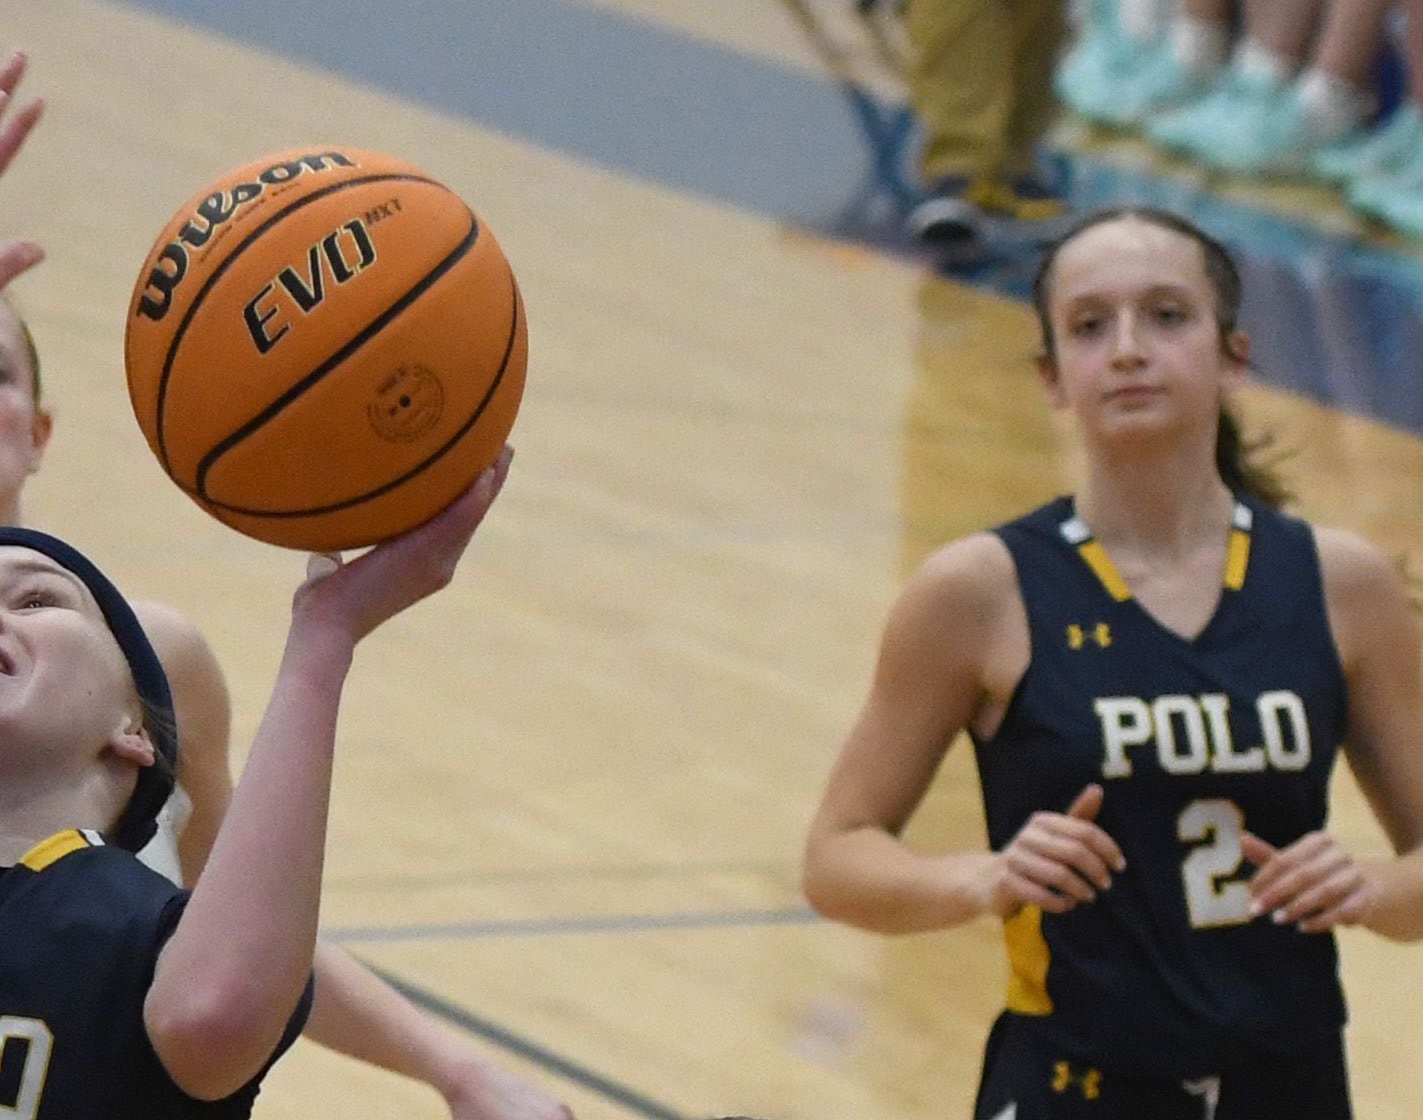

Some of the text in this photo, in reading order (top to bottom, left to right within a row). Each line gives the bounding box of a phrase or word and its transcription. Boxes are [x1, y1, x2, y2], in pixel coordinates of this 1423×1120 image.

[136, 151, 356, 322] Wilson
[242, 217, 377, 356] EVO
[1093, 689, 1313, 780] POLO
[1178, 798, 1254, 930] 2
